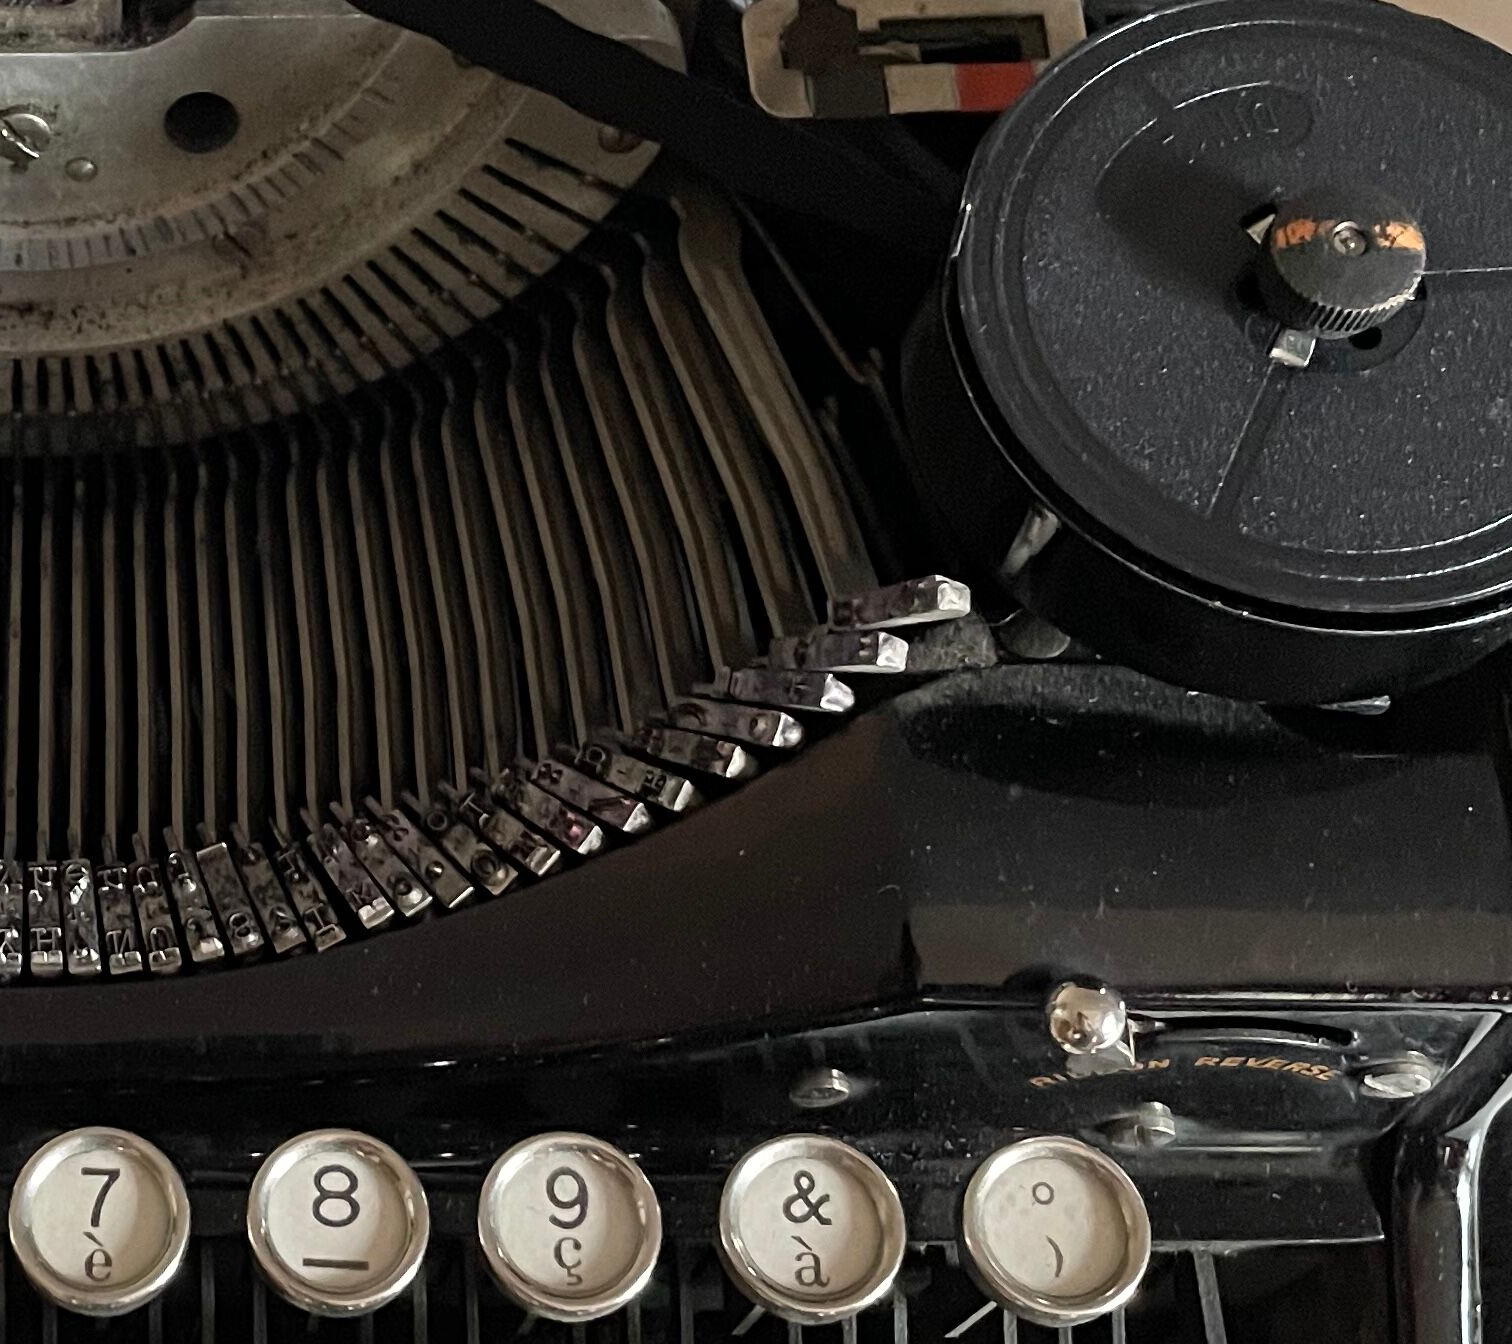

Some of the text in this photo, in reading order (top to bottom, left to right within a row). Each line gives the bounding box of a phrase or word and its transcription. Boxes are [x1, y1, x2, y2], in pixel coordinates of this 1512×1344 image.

[1194, 1056, 1341, 1082] REVERSE
[81, 1167, 120, 1227] 7
[313, 1165, 360, 1227] 8
[546, 1167, 588, 1229] 9
[783, 1171, 832, 1225] &
[82, 1231, 113, 1282] è
[553, 1234, 583, 1286] ç
[792, 1236, 831, 1288] à
